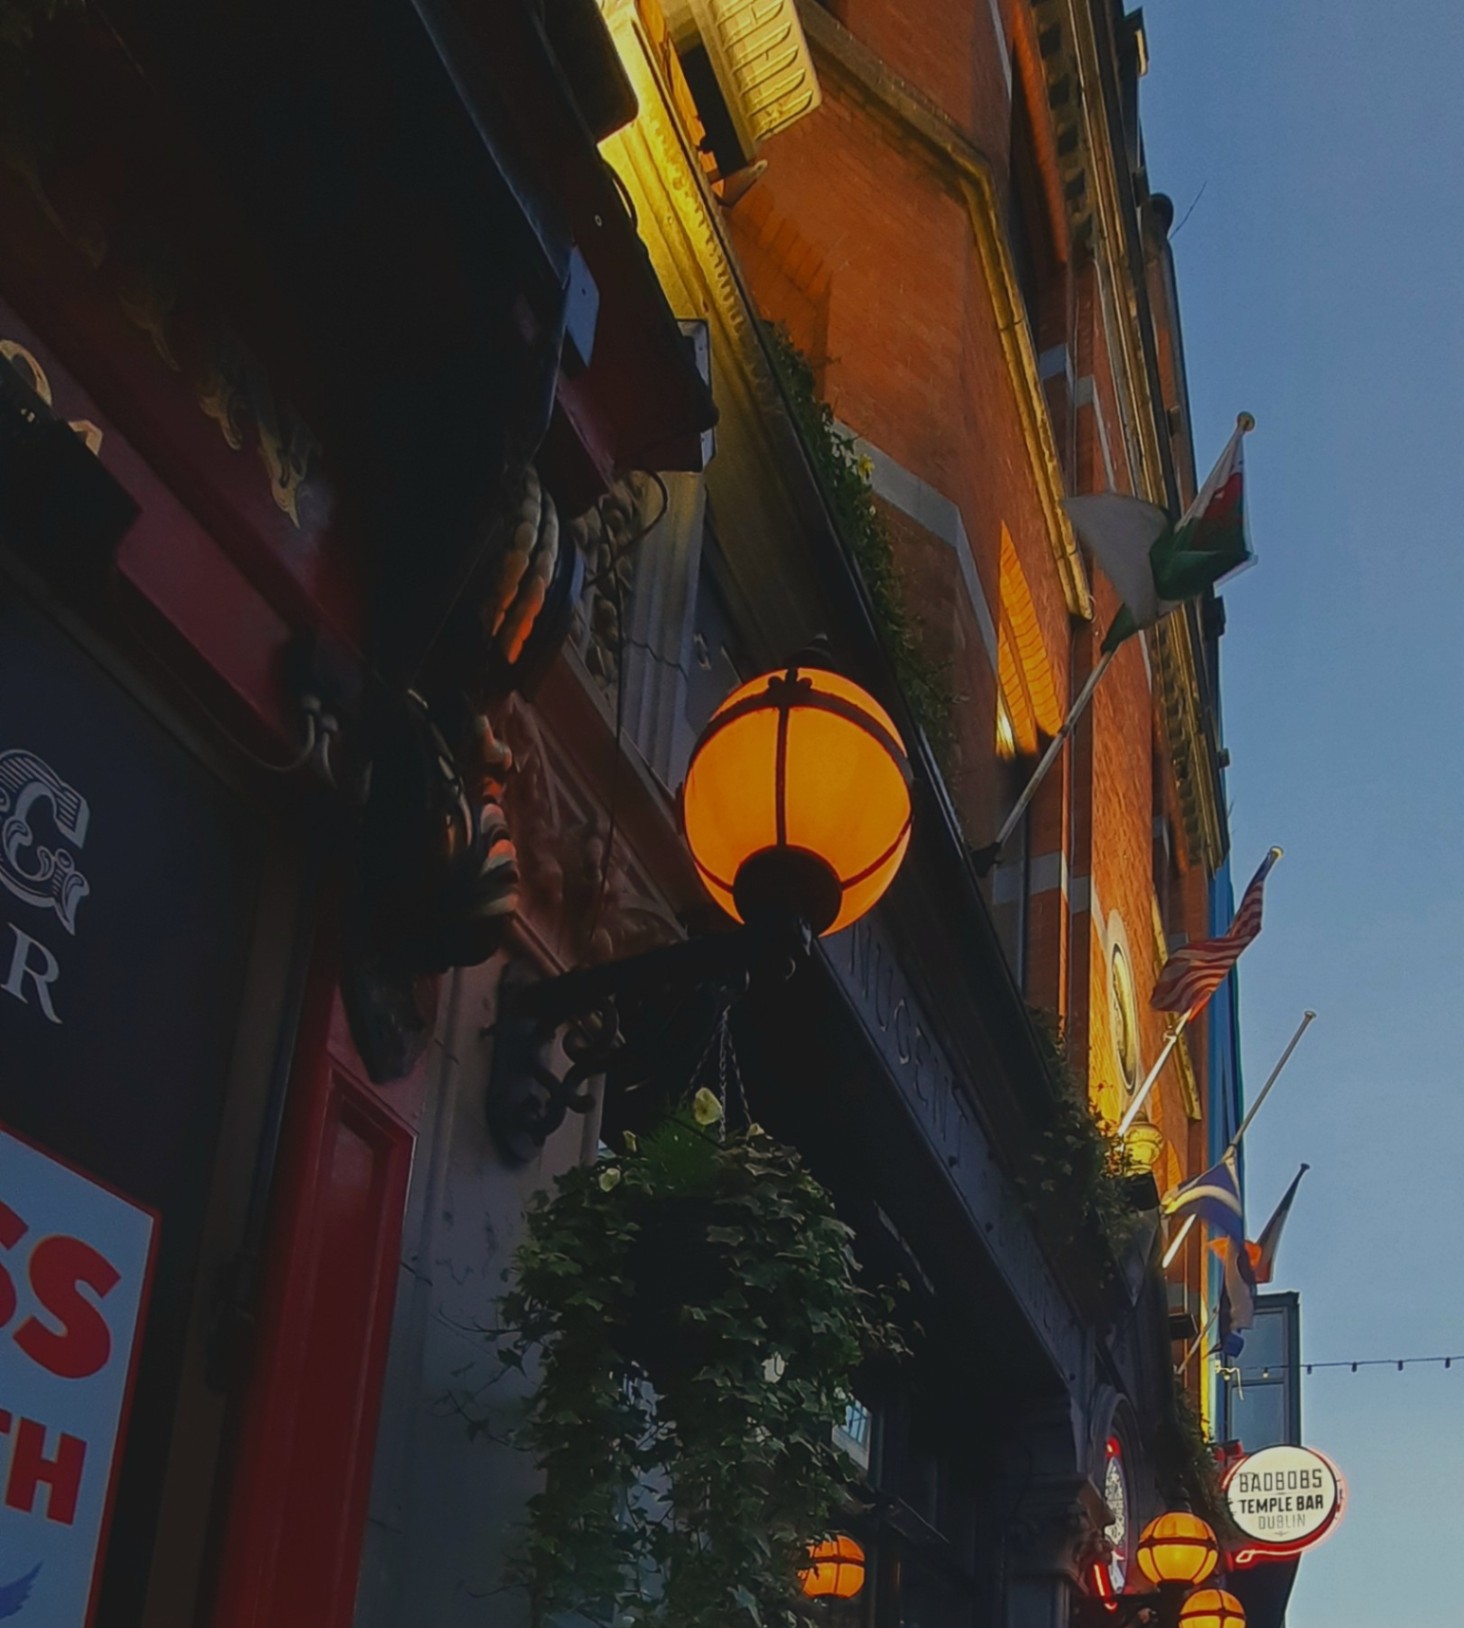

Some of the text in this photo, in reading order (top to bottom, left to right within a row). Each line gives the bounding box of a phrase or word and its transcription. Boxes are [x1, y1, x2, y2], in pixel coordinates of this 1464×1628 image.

[0, 1408, 88, 1526] H
[1239, 1469, 1322, 1493] BADBOBS
[1240, 1494, 1323, 1514] TEMPLE BAR
[1258, 1514, 1306, 1530] DUBLIN
